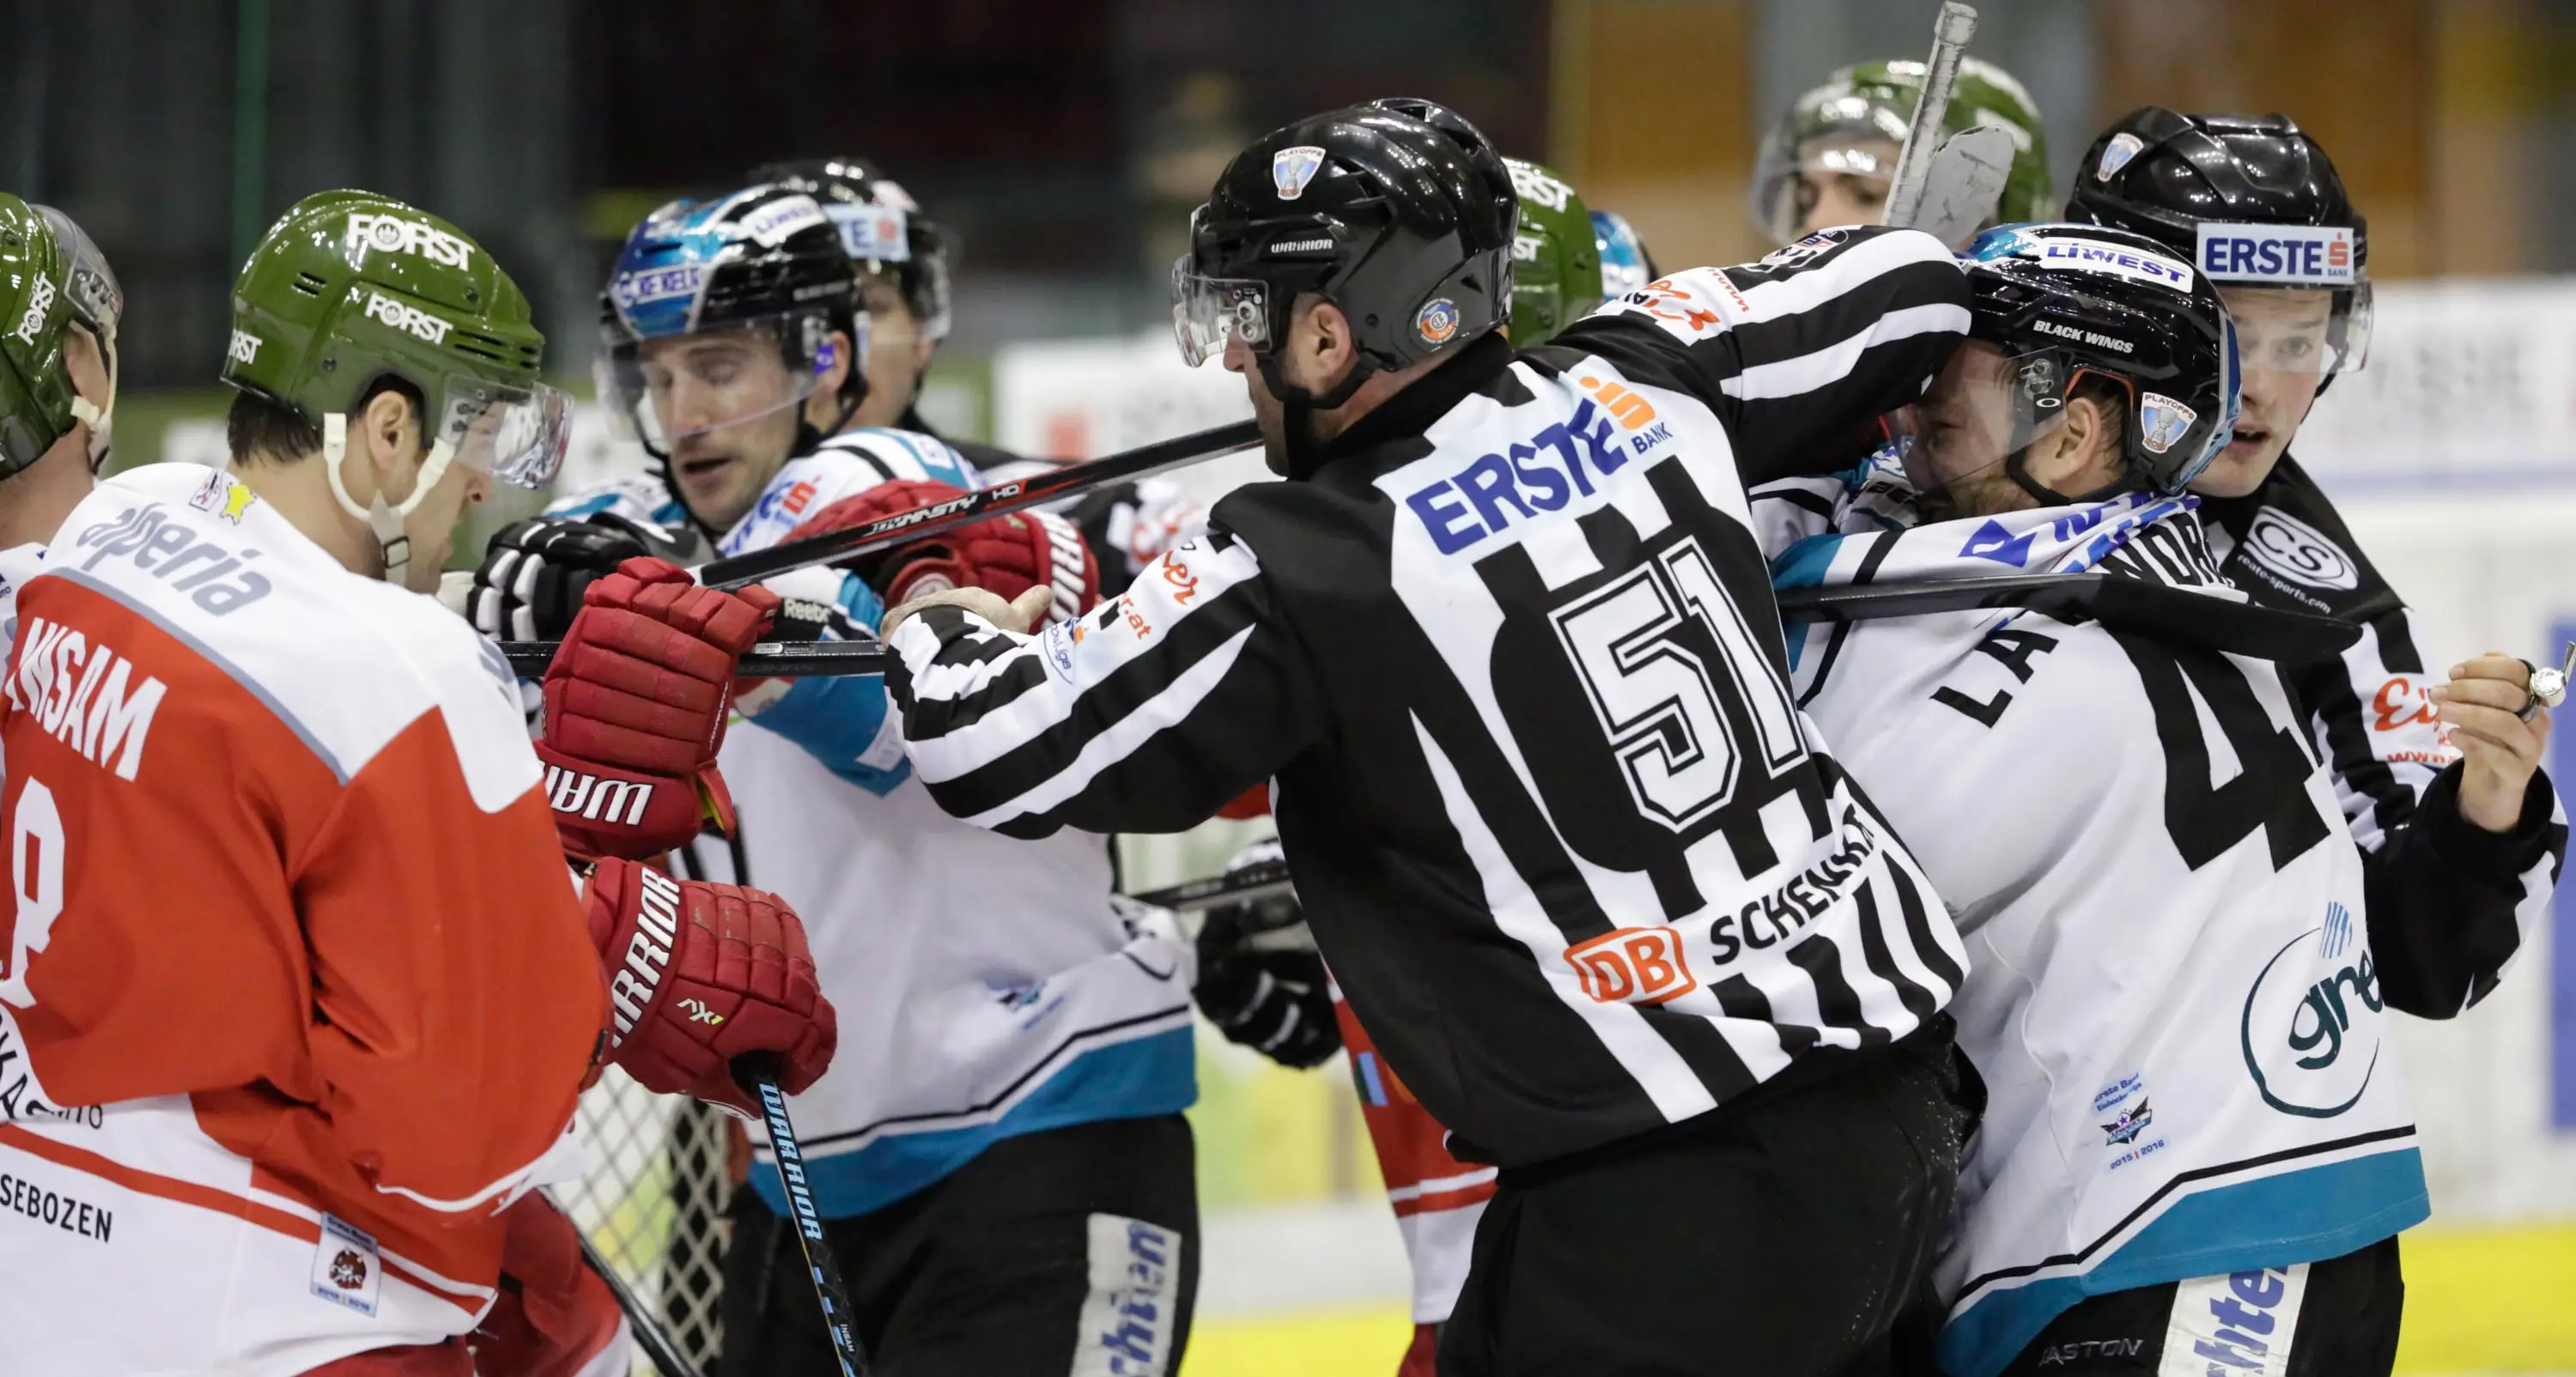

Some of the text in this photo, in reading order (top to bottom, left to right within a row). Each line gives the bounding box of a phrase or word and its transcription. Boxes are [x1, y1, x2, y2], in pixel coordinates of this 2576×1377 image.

[346, 213, 475, 271] FORST
[1271, 240, 1334, 254] WARRIOR
[2205, 236, 2323, 276] ERSTE
[2327, 268, 2349, 278] BANK
[17, 270, 57, 347] FORST
[364, 292, 454, 345] FORST
[2032, 319, 2136, 355] BLACK WINGS
[2144, 394, 2196, 420] PLAYOFFS
[1405, 397, 1674, 555] ERSTE BANK
[76, 502, 273, 616] alperia
[2254, 520, 2331, 572] CS
[1548, 536, 1809, 834] 51
[1582, 936, 1679, 1002] DB
[759, 1083, 823, 1241] WARRIOR
[2110, 1139, 2166, 1170] 2015 2016
